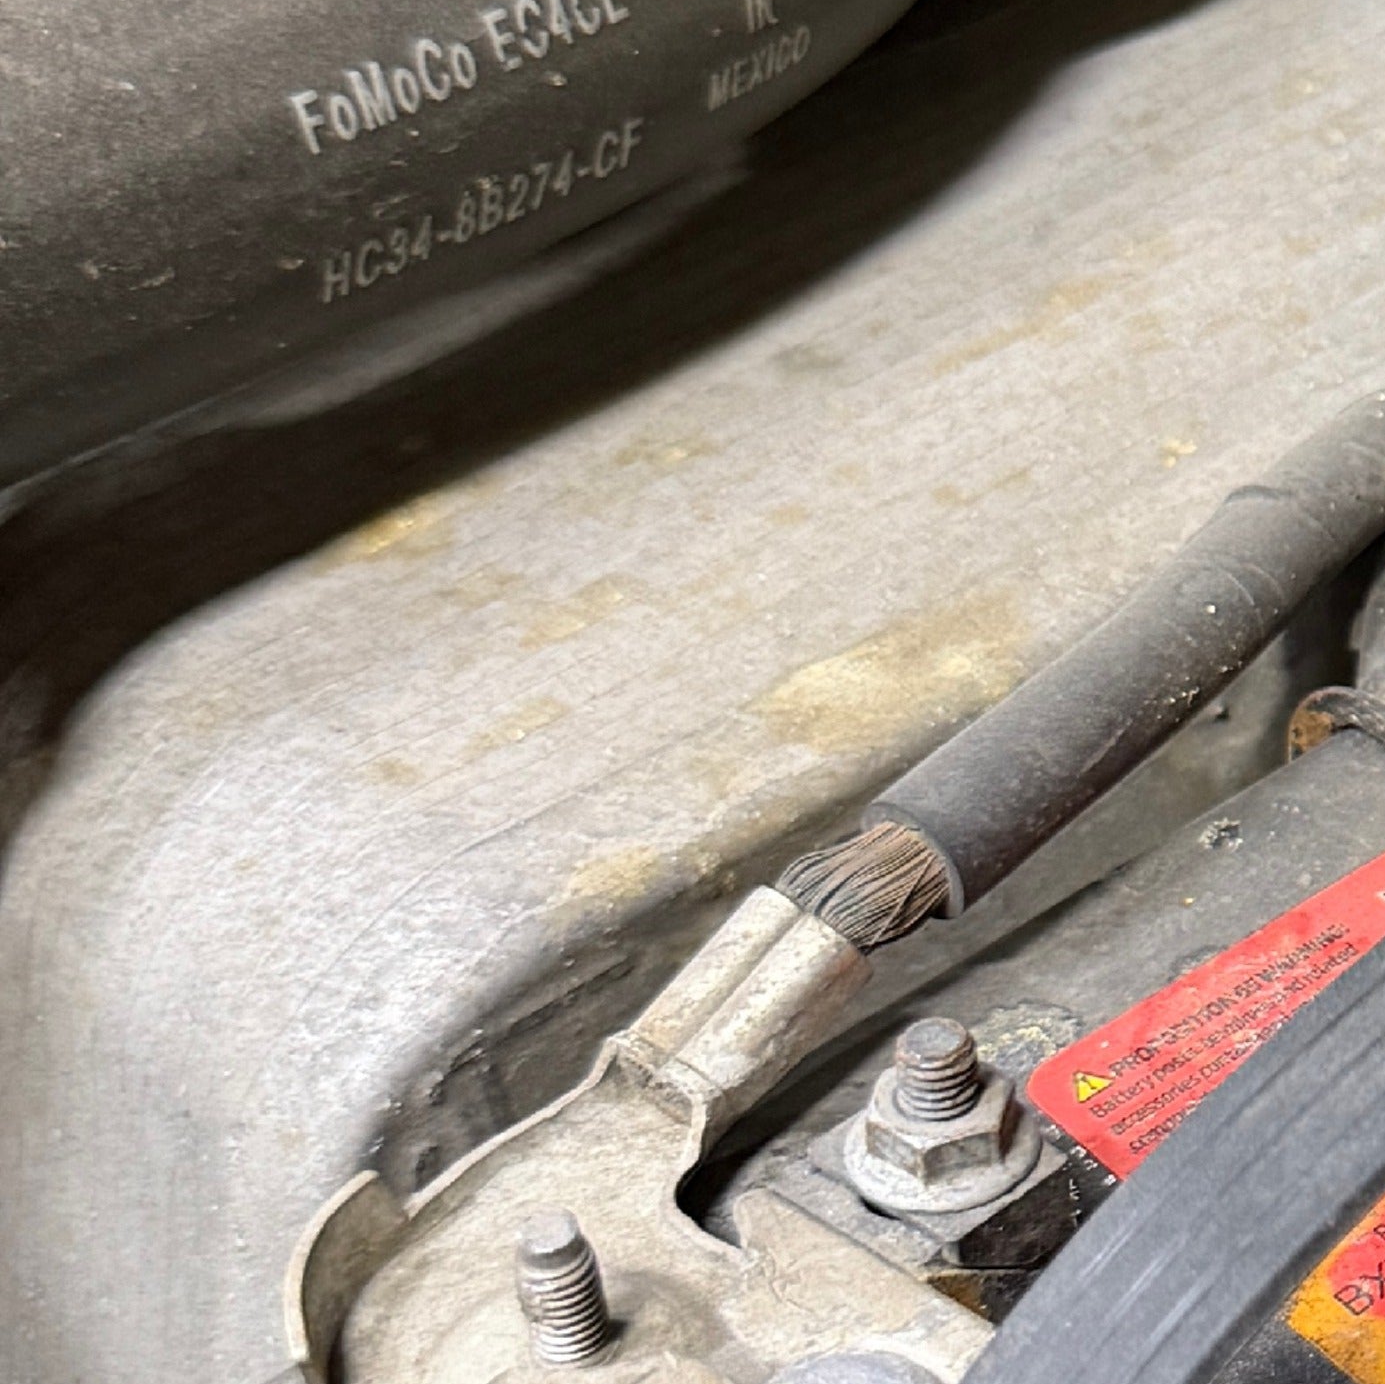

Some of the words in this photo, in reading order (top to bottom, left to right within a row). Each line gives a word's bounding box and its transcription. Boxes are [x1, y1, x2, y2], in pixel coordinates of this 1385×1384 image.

[290, 36, 478, 155] FoMoCo
[707, 25, 811, 111] MEXICO
[1089, 1071, 1155, 1120] Battery
[1306, 942, 1360, 989] related
[1111, 1077, 1201, 1137] accessories
